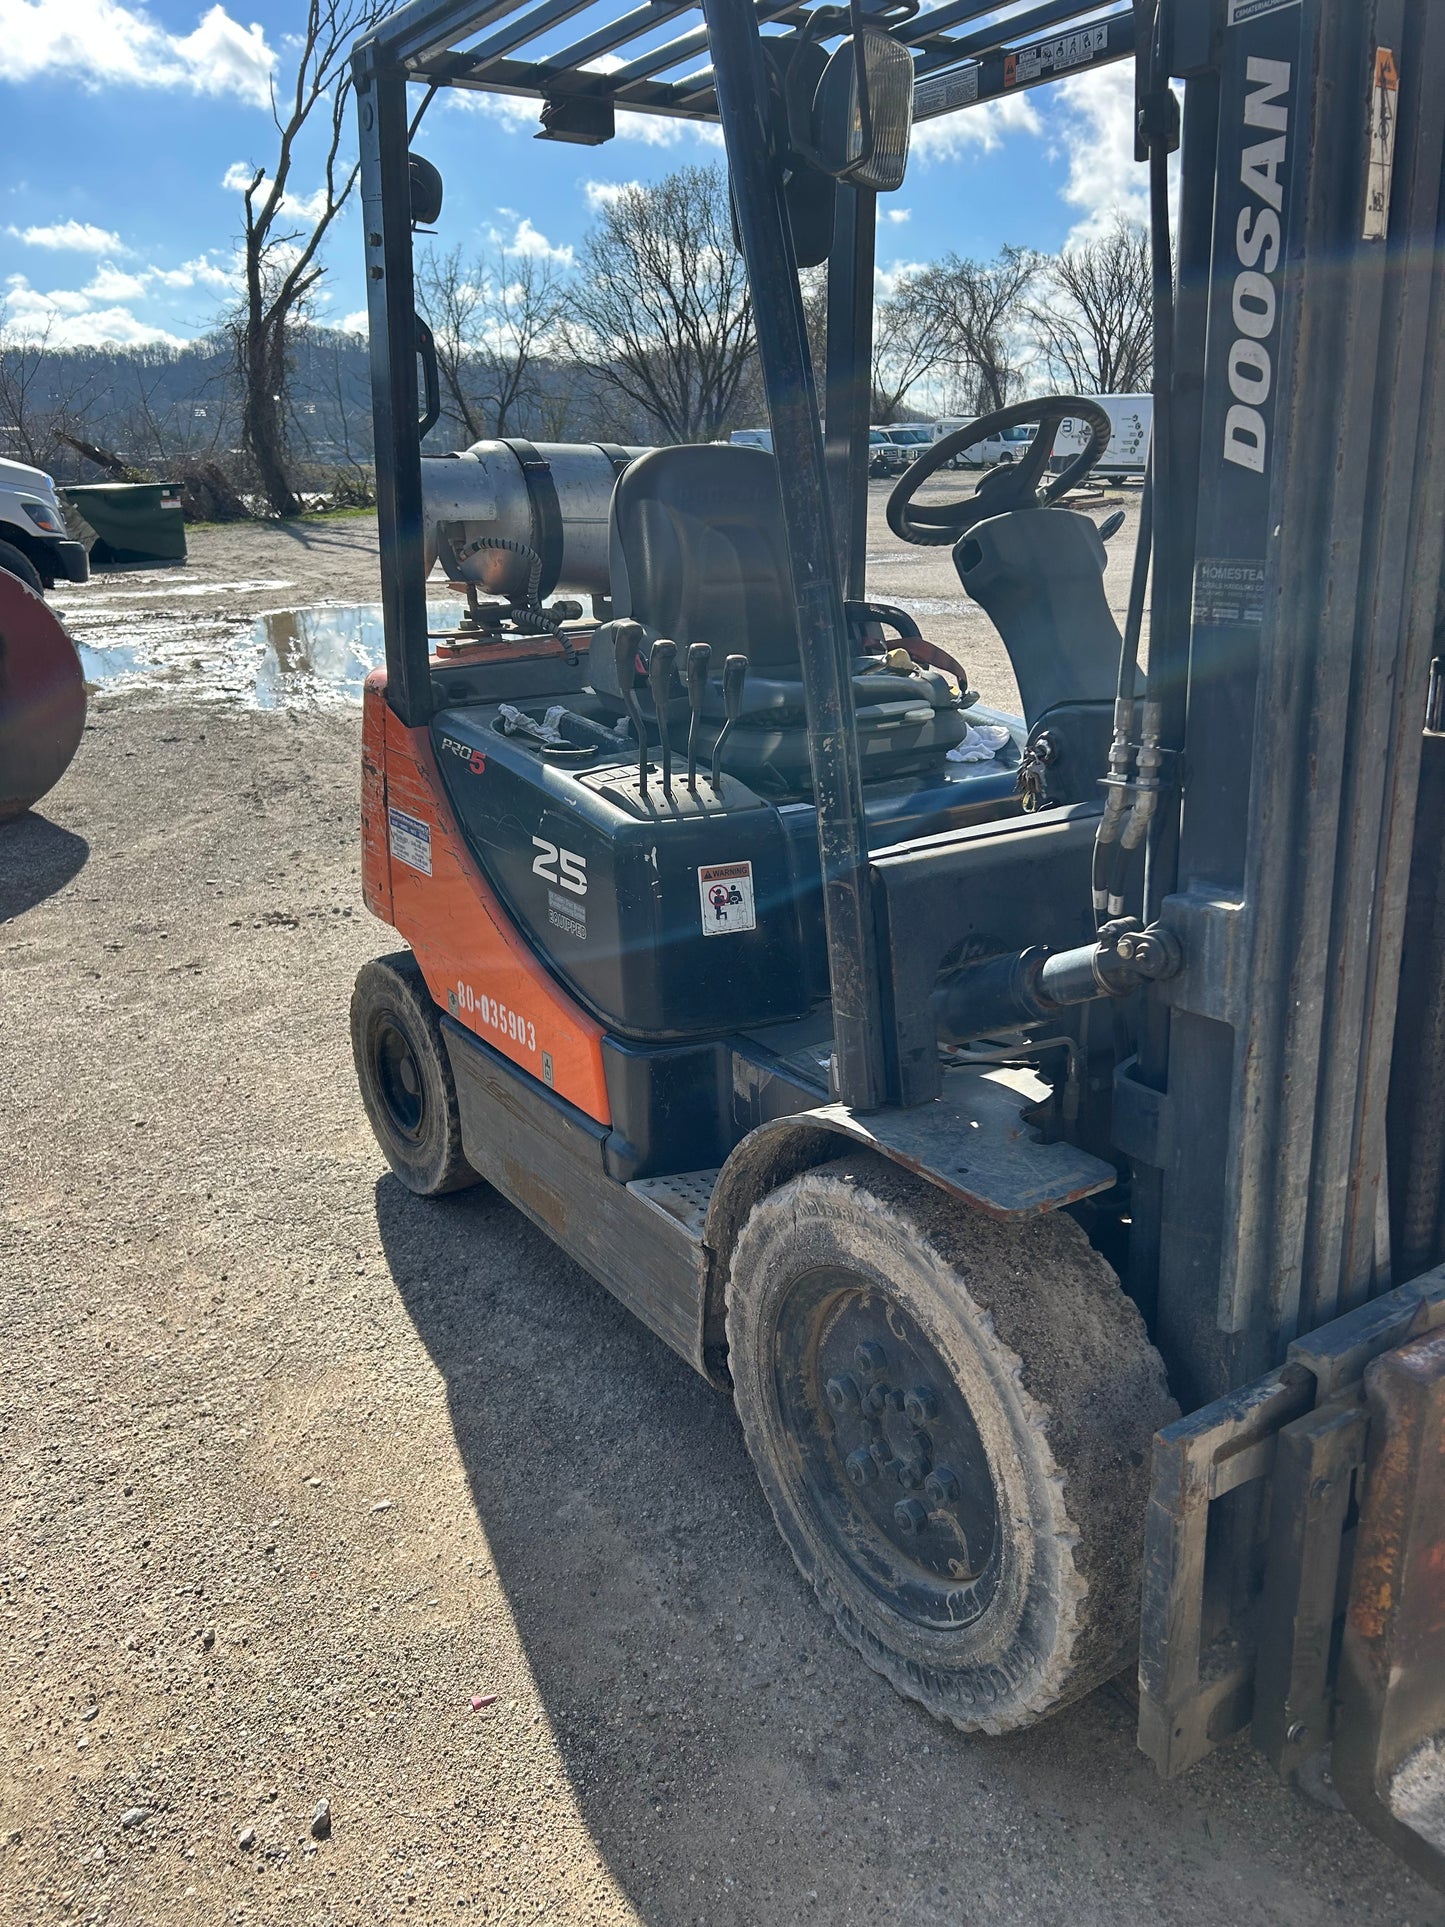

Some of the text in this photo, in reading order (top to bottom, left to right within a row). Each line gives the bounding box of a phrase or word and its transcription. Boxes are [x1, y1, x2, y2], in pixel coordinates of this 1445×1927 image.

[1223, 55, 1291, 474] DOOSAN
[532, 835, 588, 896] 25
[712, 866, 747, 878] WARNING
[548, 908, 587, 940] EQUIPPED
[457, 979, 537, 1053] 80-035903
